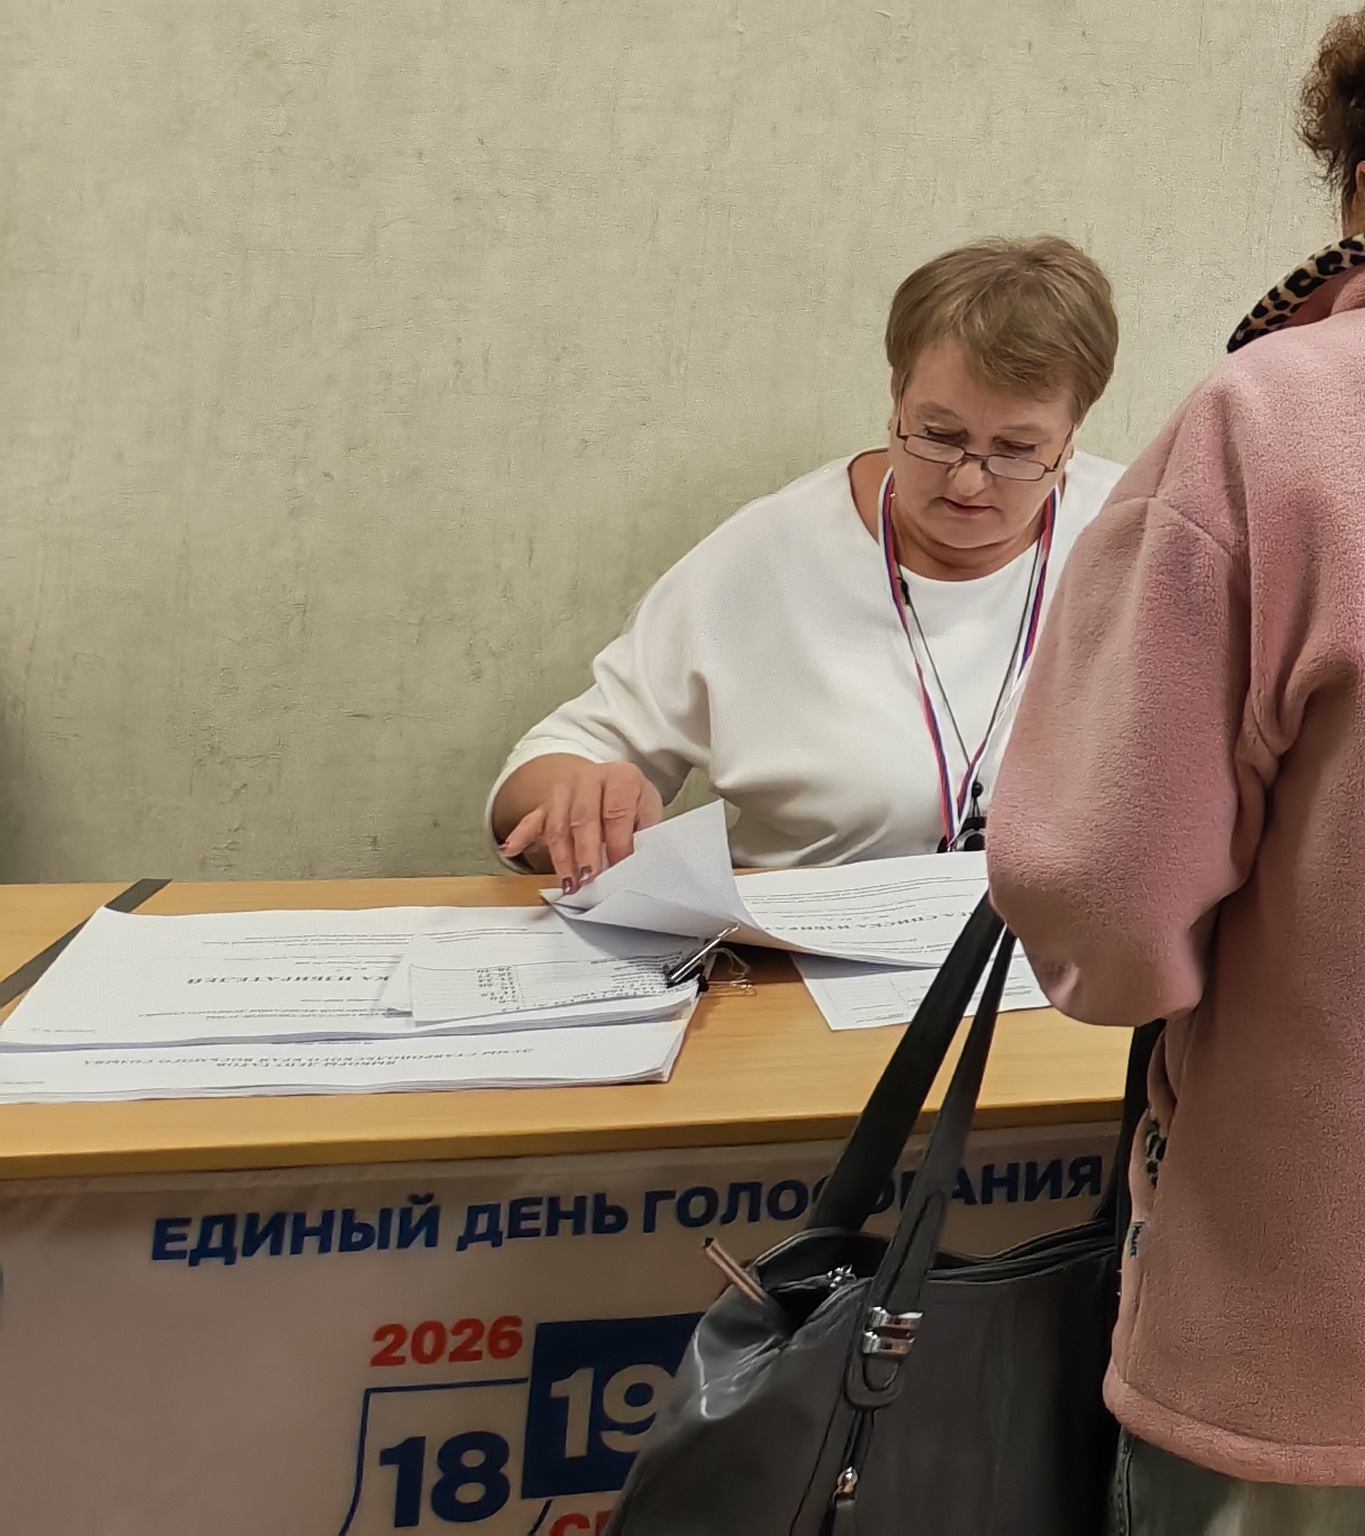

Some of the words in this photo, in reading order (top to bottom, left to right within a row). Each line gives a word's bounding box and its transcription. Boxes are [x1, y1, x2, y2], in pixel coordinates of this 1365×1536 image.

[150, 1194, 440, 1267] ЕДИНЫЙ
[455, 1192, 630, 1251] ДЕНЬ
[369, 1313, 525, 1369] 2026
[377, 1428, 512, 1530] 18
